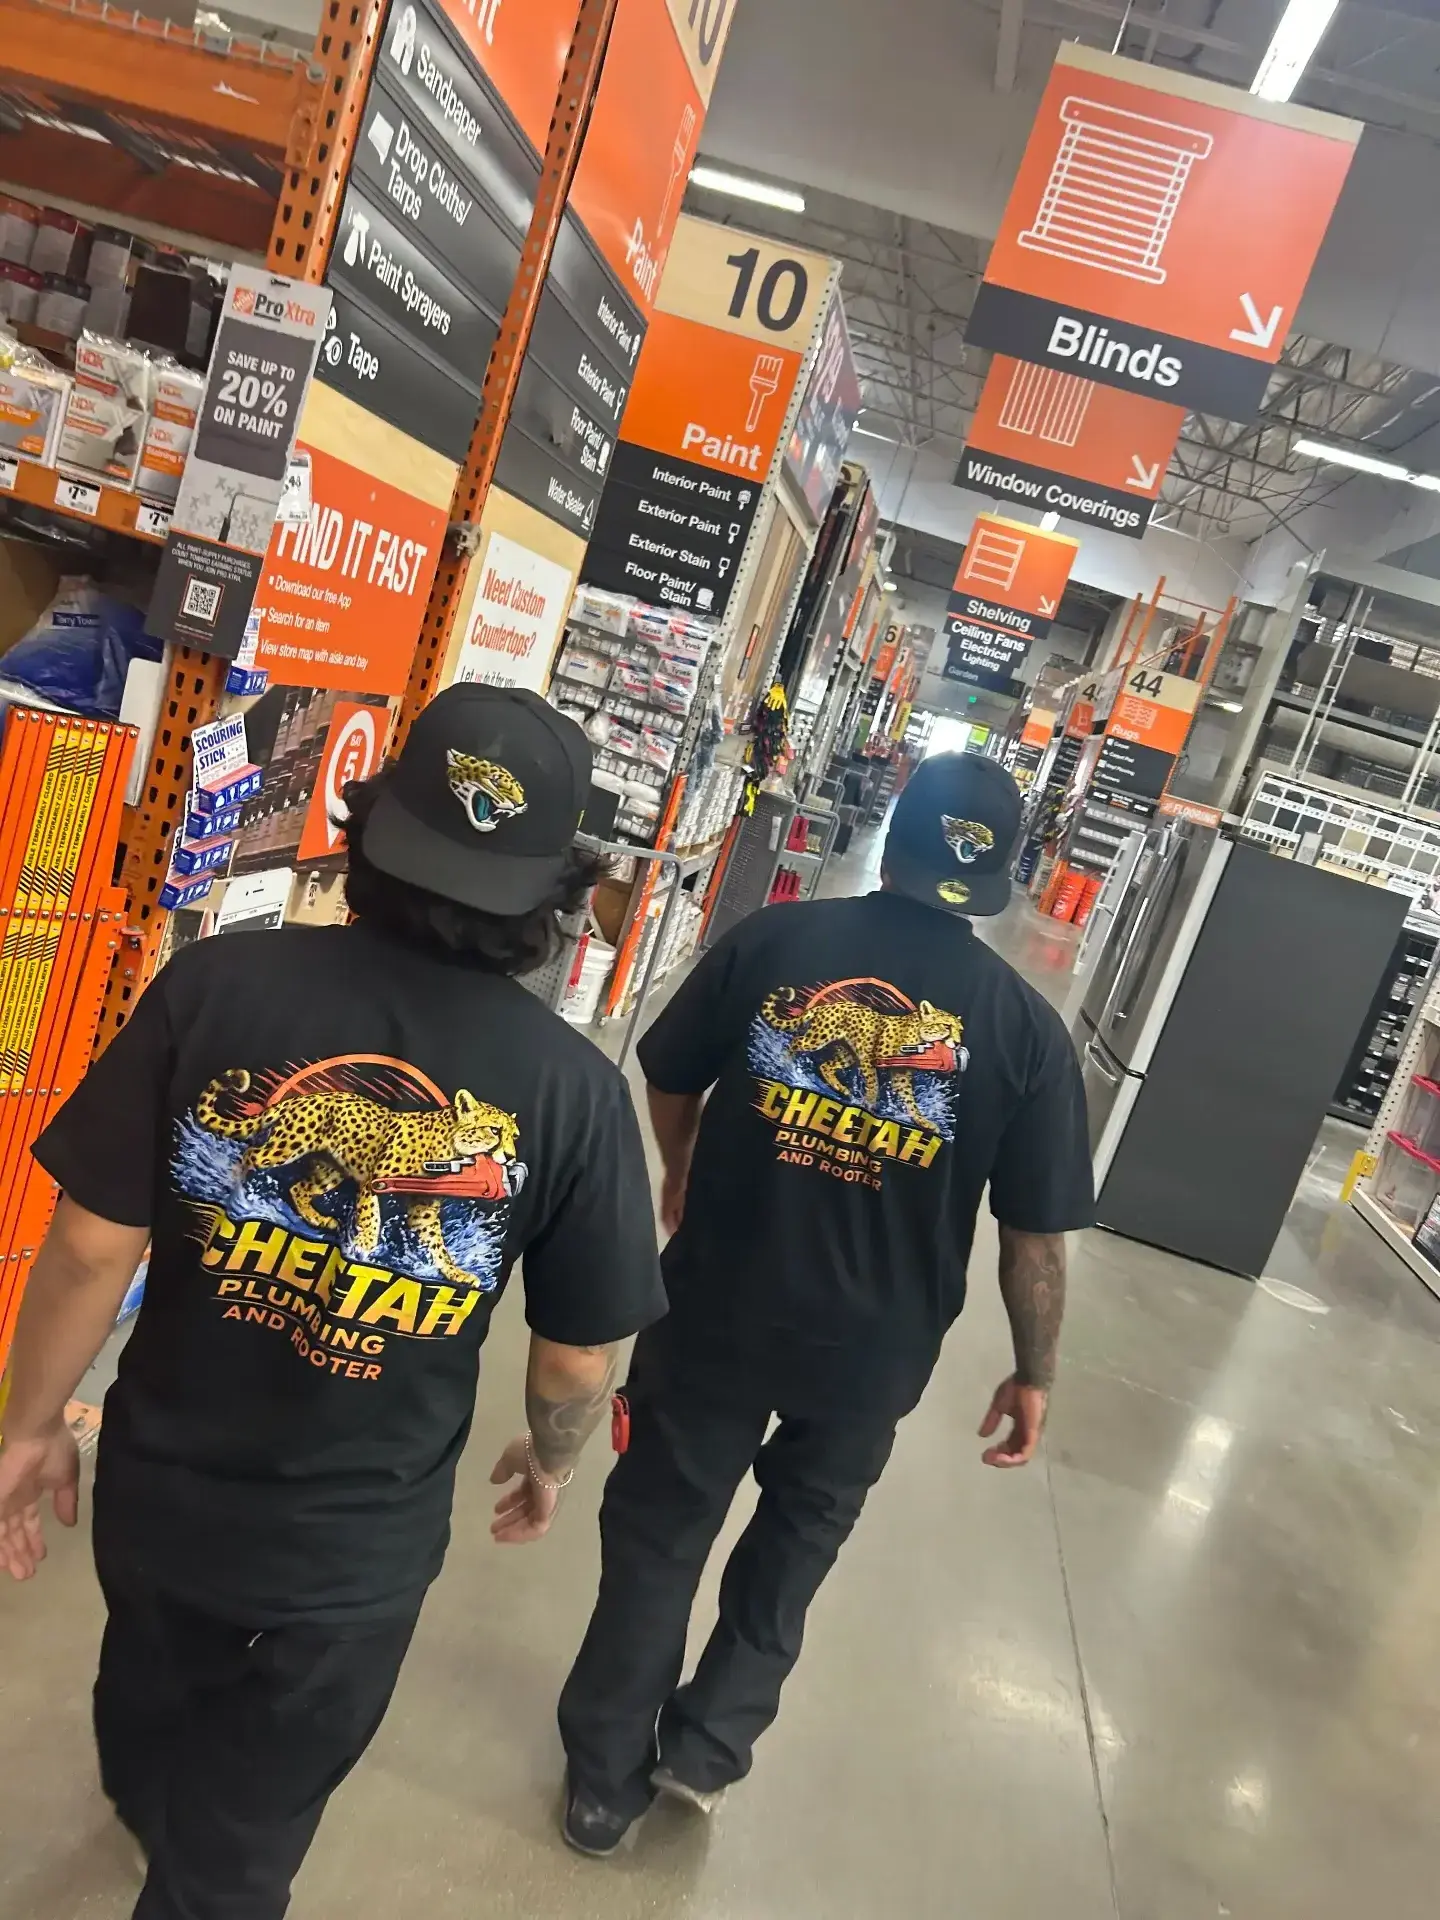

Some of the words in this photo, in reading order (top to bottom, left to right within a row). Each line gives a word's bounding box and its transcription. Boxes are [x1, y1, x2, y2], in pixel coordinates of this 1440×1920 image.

[417, 44, 482, 147] Sandpaper
[388, 158, 422, 220] Tarps
[395, 120, 428, 184] Drop
[429, 161, 473, 226] Cloths/
[626, 217, 661, 303] Paint
[367, 239, 403, 295] Paint
[402, 271, 451, 336] Sprayers
[726, 247, 809, 332] 10
[597, 296, 618, 337] Interior
[615, 321, 633, 353] Paint
[227, 350, 260, 372] SAVE
[261, 360, 279, 376] UP
[280, 367, 296, 382] TO
[347, 332, 379, 380] Tape
[1046, 316, 1183, 388] Blinds
[217, 369, 288, 418] 20%
[577, 354, 601, 393] Exterior
[599, 376, 616, 408] Paint
[213, 405, 236, 426] ON
[238, 412, 283, 439] PAINT
[571, 406, 588, 436] Floor
[580, 445, 597, 473] Stain
[681, 422, 763, 472] Paint
[547, 476, 566, 507] Water
[652, 466, 698, 492] Interior
[698, 481, 733, 502] Paint
[966, 460, 1042, 500] Window
[1045, 485, 1141, 528] Coverings
[637, 499, 688, 525] Exterior
[688, 515, 722, 536] Paint
[276, 502, 344, 571] FIND
[341, 520, 373, 579] IT
[367, 529, 428, 596] FAST
[628, 533, 679, 559] Exterior
[679, 549, 711, 570] Stain
[275, 576, 313, 599] Download
[312, 588, 325, 601] our
[324, 587, 338, 604] free
[337, 592, 352, 609] App
[482, 568, 514, 607] Need
[510, 579, 546, 620] Custom
[625, 561, 658, 582] Floor
[658, 572, 697, 593] Paint/
[659, 587, 692, 607] Stain
[267, 608, 294, 626] Search
[295, 614, 305, 628] for
[304, 618, 315, 630] an
[315, 619, 331, 633] item
[641, 624, 662, 636] Tyvek
[885, 625, 898, 643] 6
[966, 599, 1032, 633] Shelving
[260, 637, 279, 656] View
[279, 643, 298, 659] store
[298, 648, 315, 663] map
[314, 648, 329, 663] with
[328, 650, 343, 665] aisle
[343, 651, 356, 666] and
[355, 654, 369, 671] bay
[470, 613, 537, 662] Countertops?
[681, 638, 702, 651] Tyvek
[951, 620, 993, 645] Ceiling
[994, 633, 1026, 652] Fans
[960, 639, 1012, 663] Electrical
[962, 652, 1000, 672] Lighting
[1129, 670, 1164, 698] 44
[195, 721, 244, 754] SCOURING
[350, 734, 364, 747] BAY
[1111, 724, 1141, 742] Rugs
[199, 747, 227, 771] STICK
[341, 751, 361, 786] 5
[84, 777, 95, 804] CLOSED
[27, 848, 37, 868] AISLE
[32, 800, 48, 848] TEMPORARILY
[44, 772, 54, 800] CLOSED
[40, 850, 50, 869] AISLE
[45, 801, 61, 850] TEMPORARILY
[57, 774, 68, 801] CLOSED
[54, 851, 64, 870] AISLE
[59, 803, 75, 851] TEMPORARILY
[71, 775, 81, 803] CLOSED
[72, 804, 88, 853] TEMPORARILY
[68, 852, 77, 871] AISLE
[763, 1081, 944, 1170] CHEETAH
[775, 1130, 882, 1174] PLUMBING
[776, 1150, 814, 1166] AND
[819, 1159, 882, 1192] ROOTER
[201, 1207, 485, 1337] CHEETAH
[217, 1279, 386, 1356] PLUMBING
[221, 1304, 286, 1331] AND
[290, 1322, 383, 1381] ROOTER
